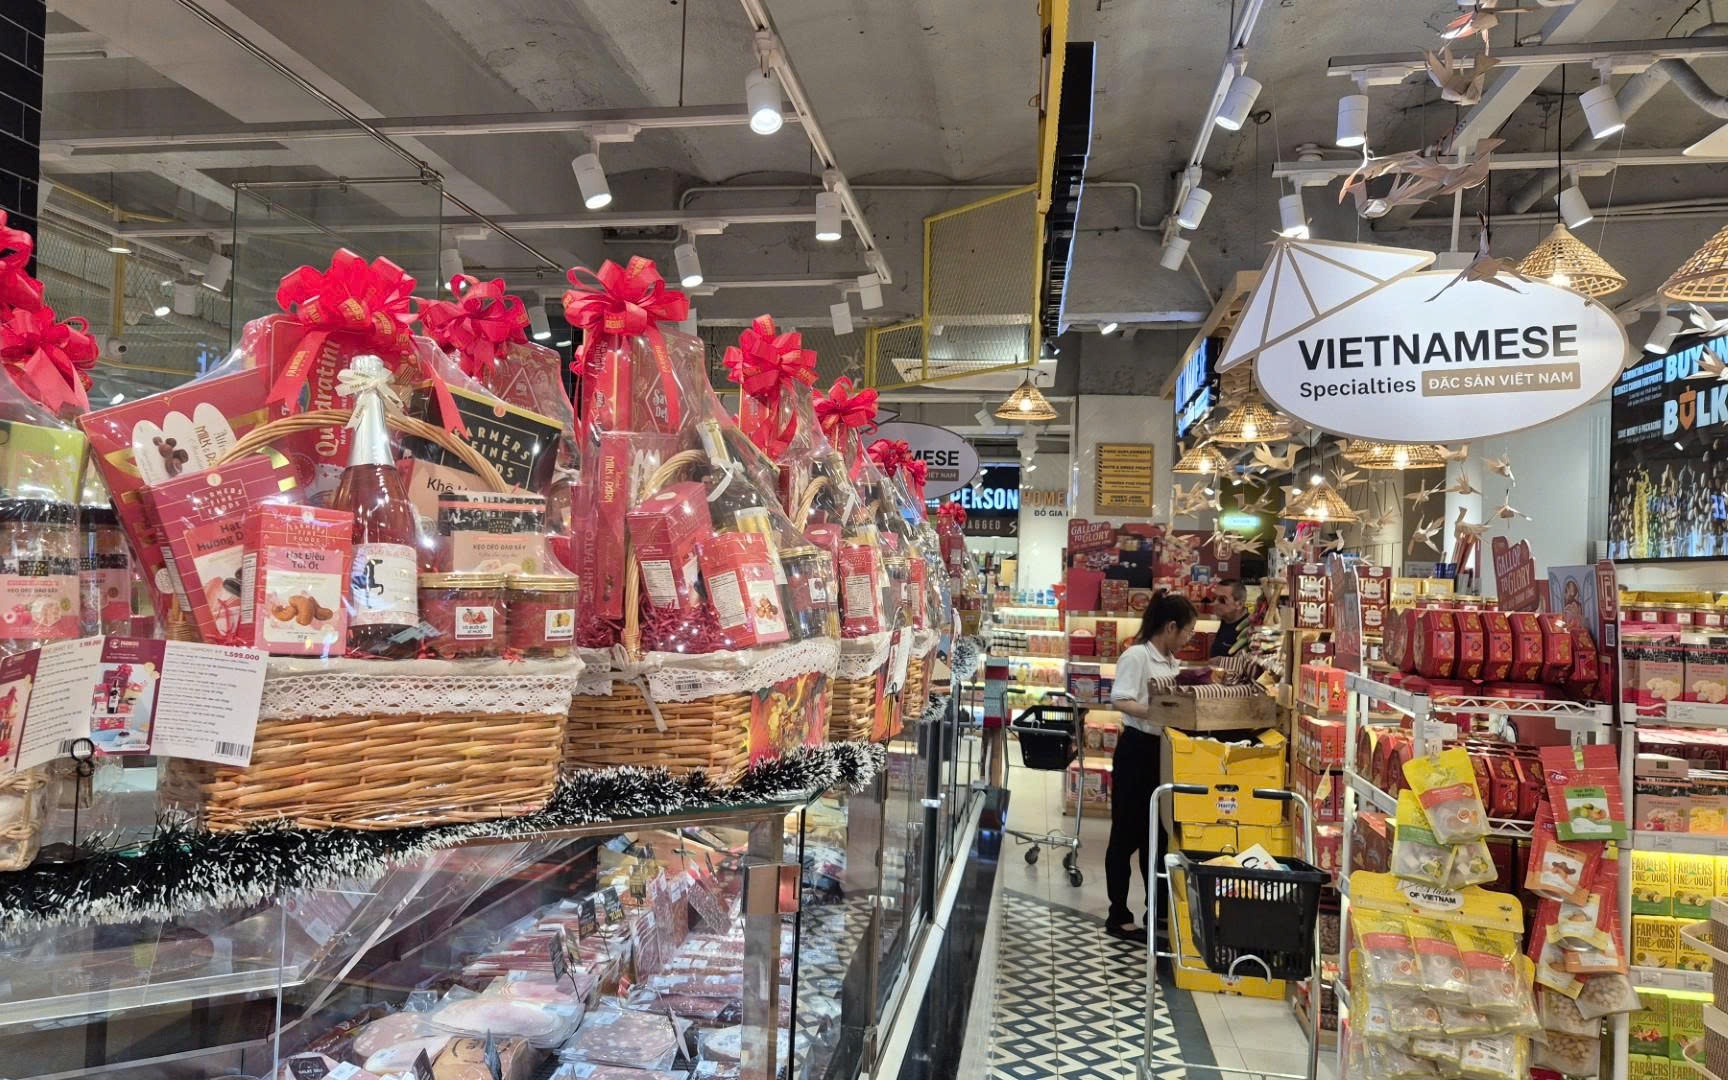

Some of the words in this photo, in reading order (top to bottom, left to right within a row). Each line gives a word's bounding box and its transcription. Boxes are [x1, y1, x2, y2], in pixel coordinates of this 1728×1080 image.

[1298, 324, 1578, 370] VIETNAMESE
[1665, 343, 1704, 383] BUY
[1538, 371, 1574, 385] NAM
[315, 340, 341, 457] Qudratini
[1299, 377, 1417, 402] Specialties
[1022, 489, 1065, 507] HOME
[1496, 544, 1522, 577] GALLOP
[1508, 563, 1531, 594] GLORY
[1673, 862, 1712, 876] FARMERS
[1421, 893, 1457, 905] VIETNAM
[1635, 921, 1675, 939] FARMERS
[1636, 936, 1653, 948] FINE
[1630, 1060, 1669, 1076] FARMERS
